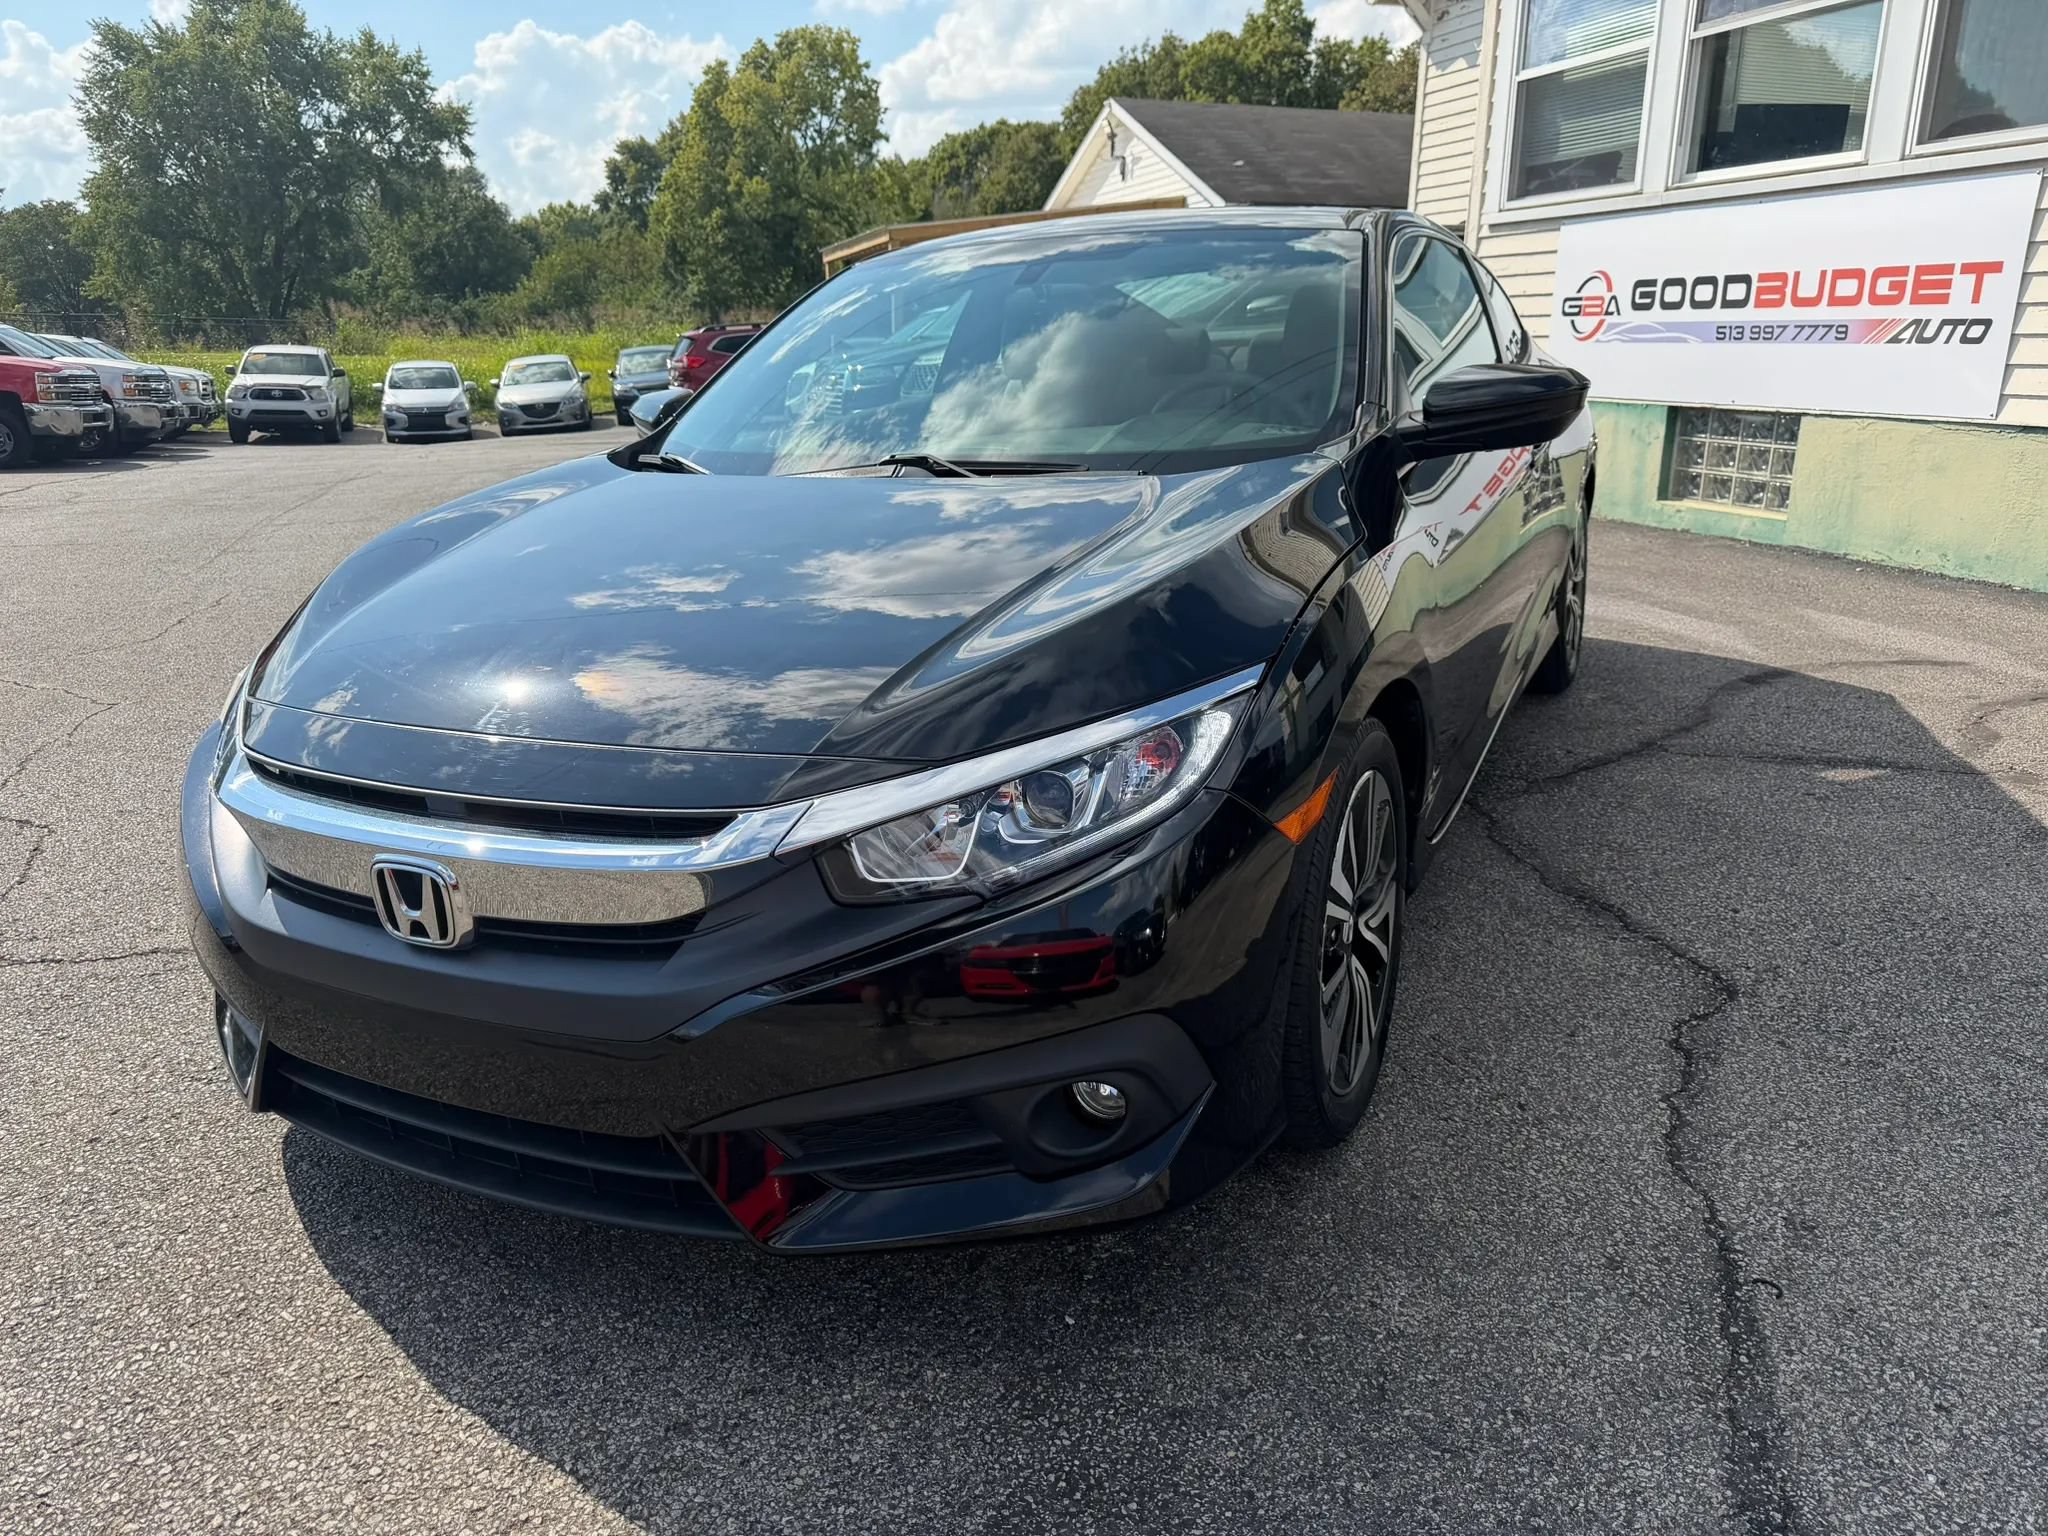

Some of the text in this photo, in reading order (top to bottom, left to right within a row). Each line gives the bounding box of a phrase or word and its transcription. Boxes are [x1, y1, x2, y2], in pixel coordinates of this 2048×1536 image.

[1562, 294, 1621, 317] GBA
[1715, 323, 1849, 342] 513 997 7779
[1884, 318, 1993, 345] AUTO
